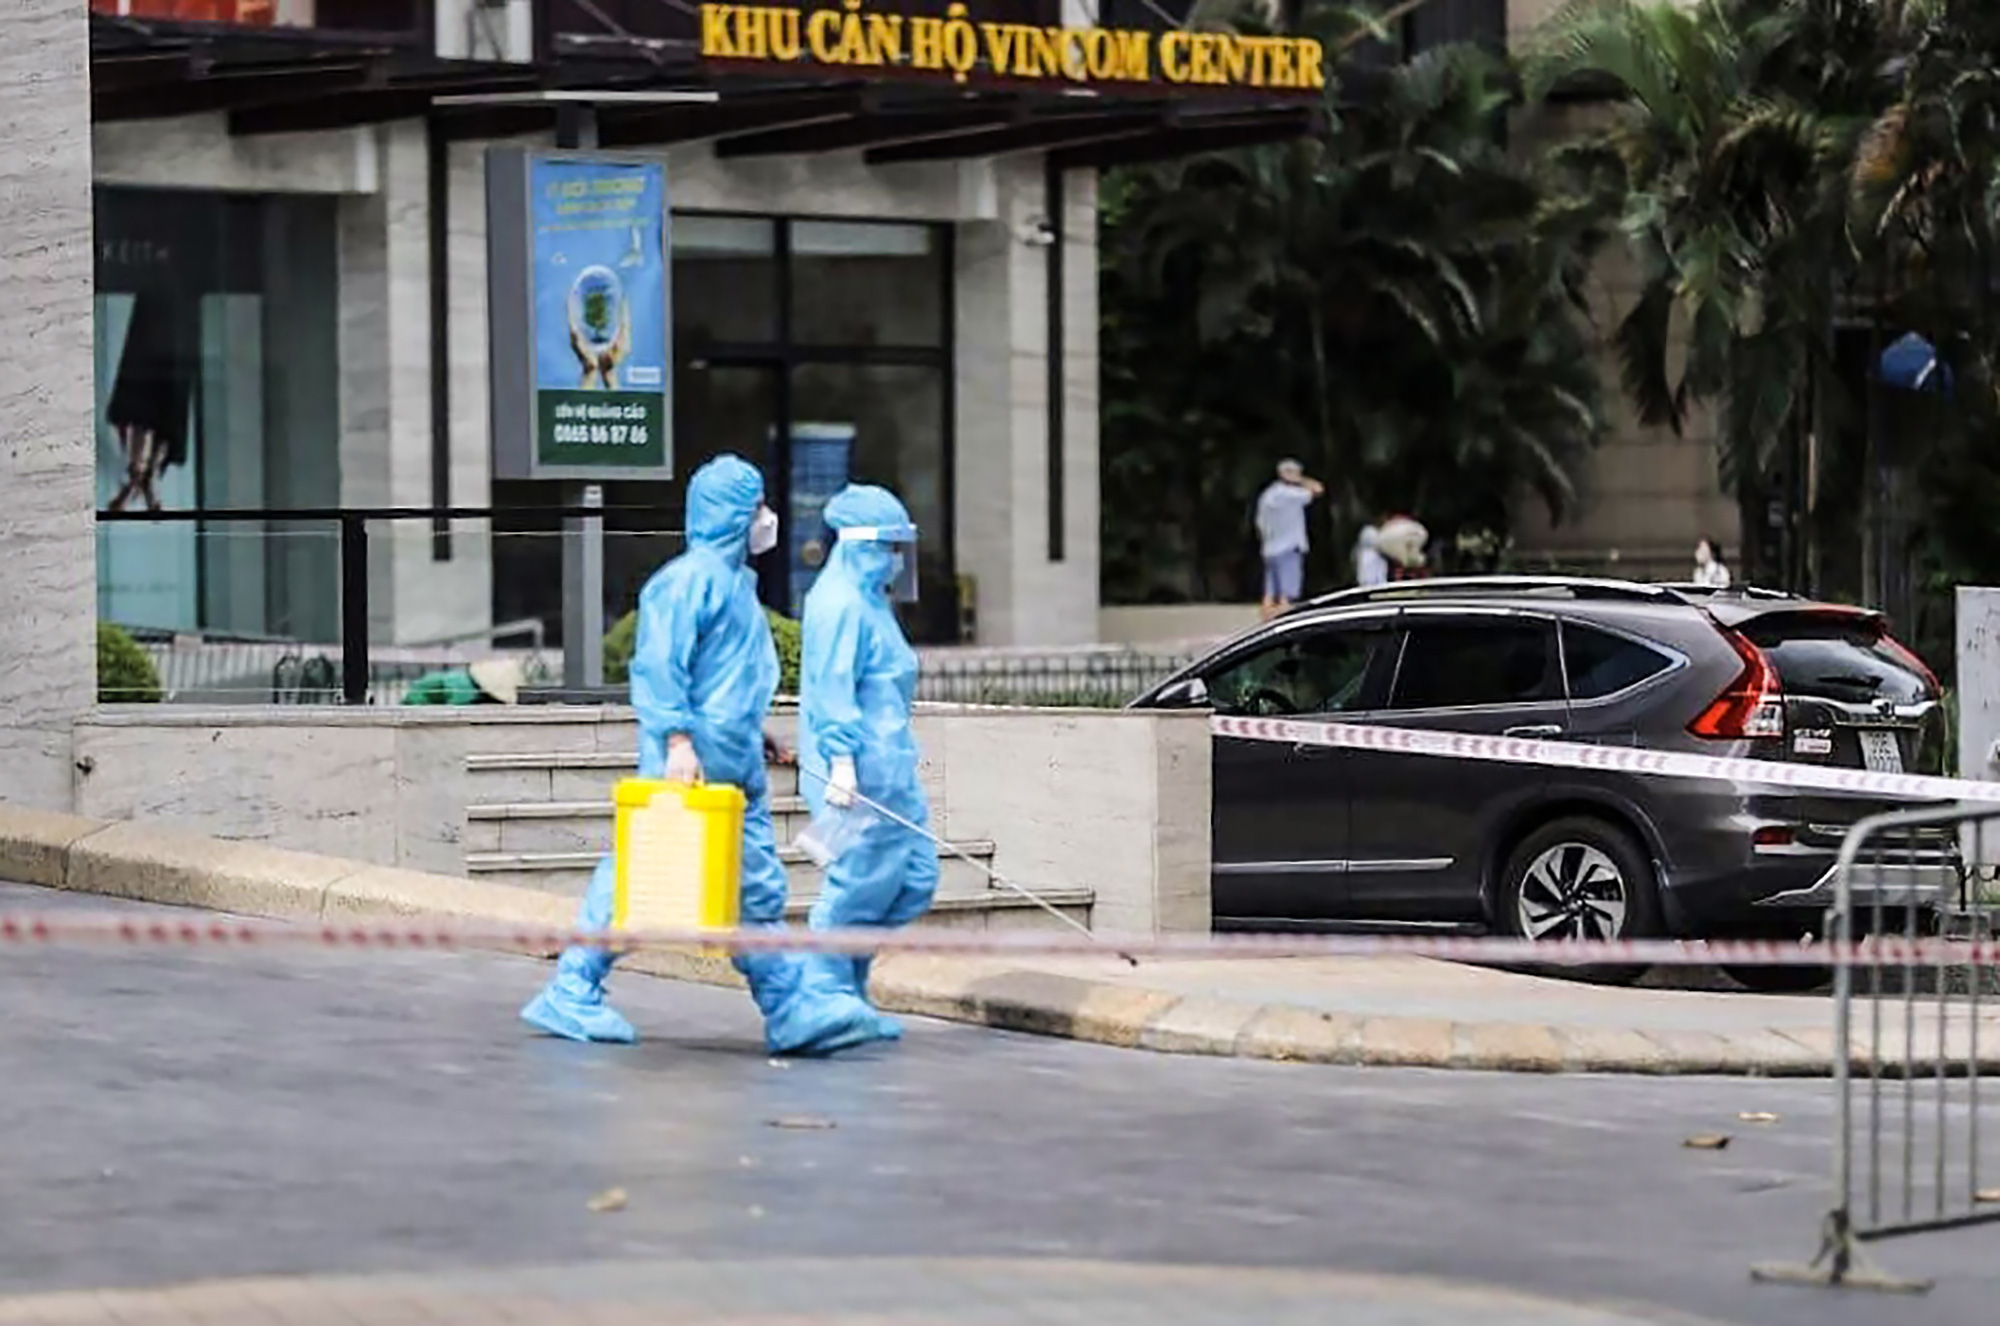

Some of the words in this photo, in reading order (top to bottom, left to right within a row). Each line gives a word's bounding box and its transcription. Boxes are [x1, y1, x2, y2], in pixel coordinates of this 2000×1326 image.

[702, 3, 800, 60] KHU
[909, 3, 978, 83] HỘ
[980, 22, 1148, 82] VINCOM
[1160, 30, 1325, 89] CENTER
